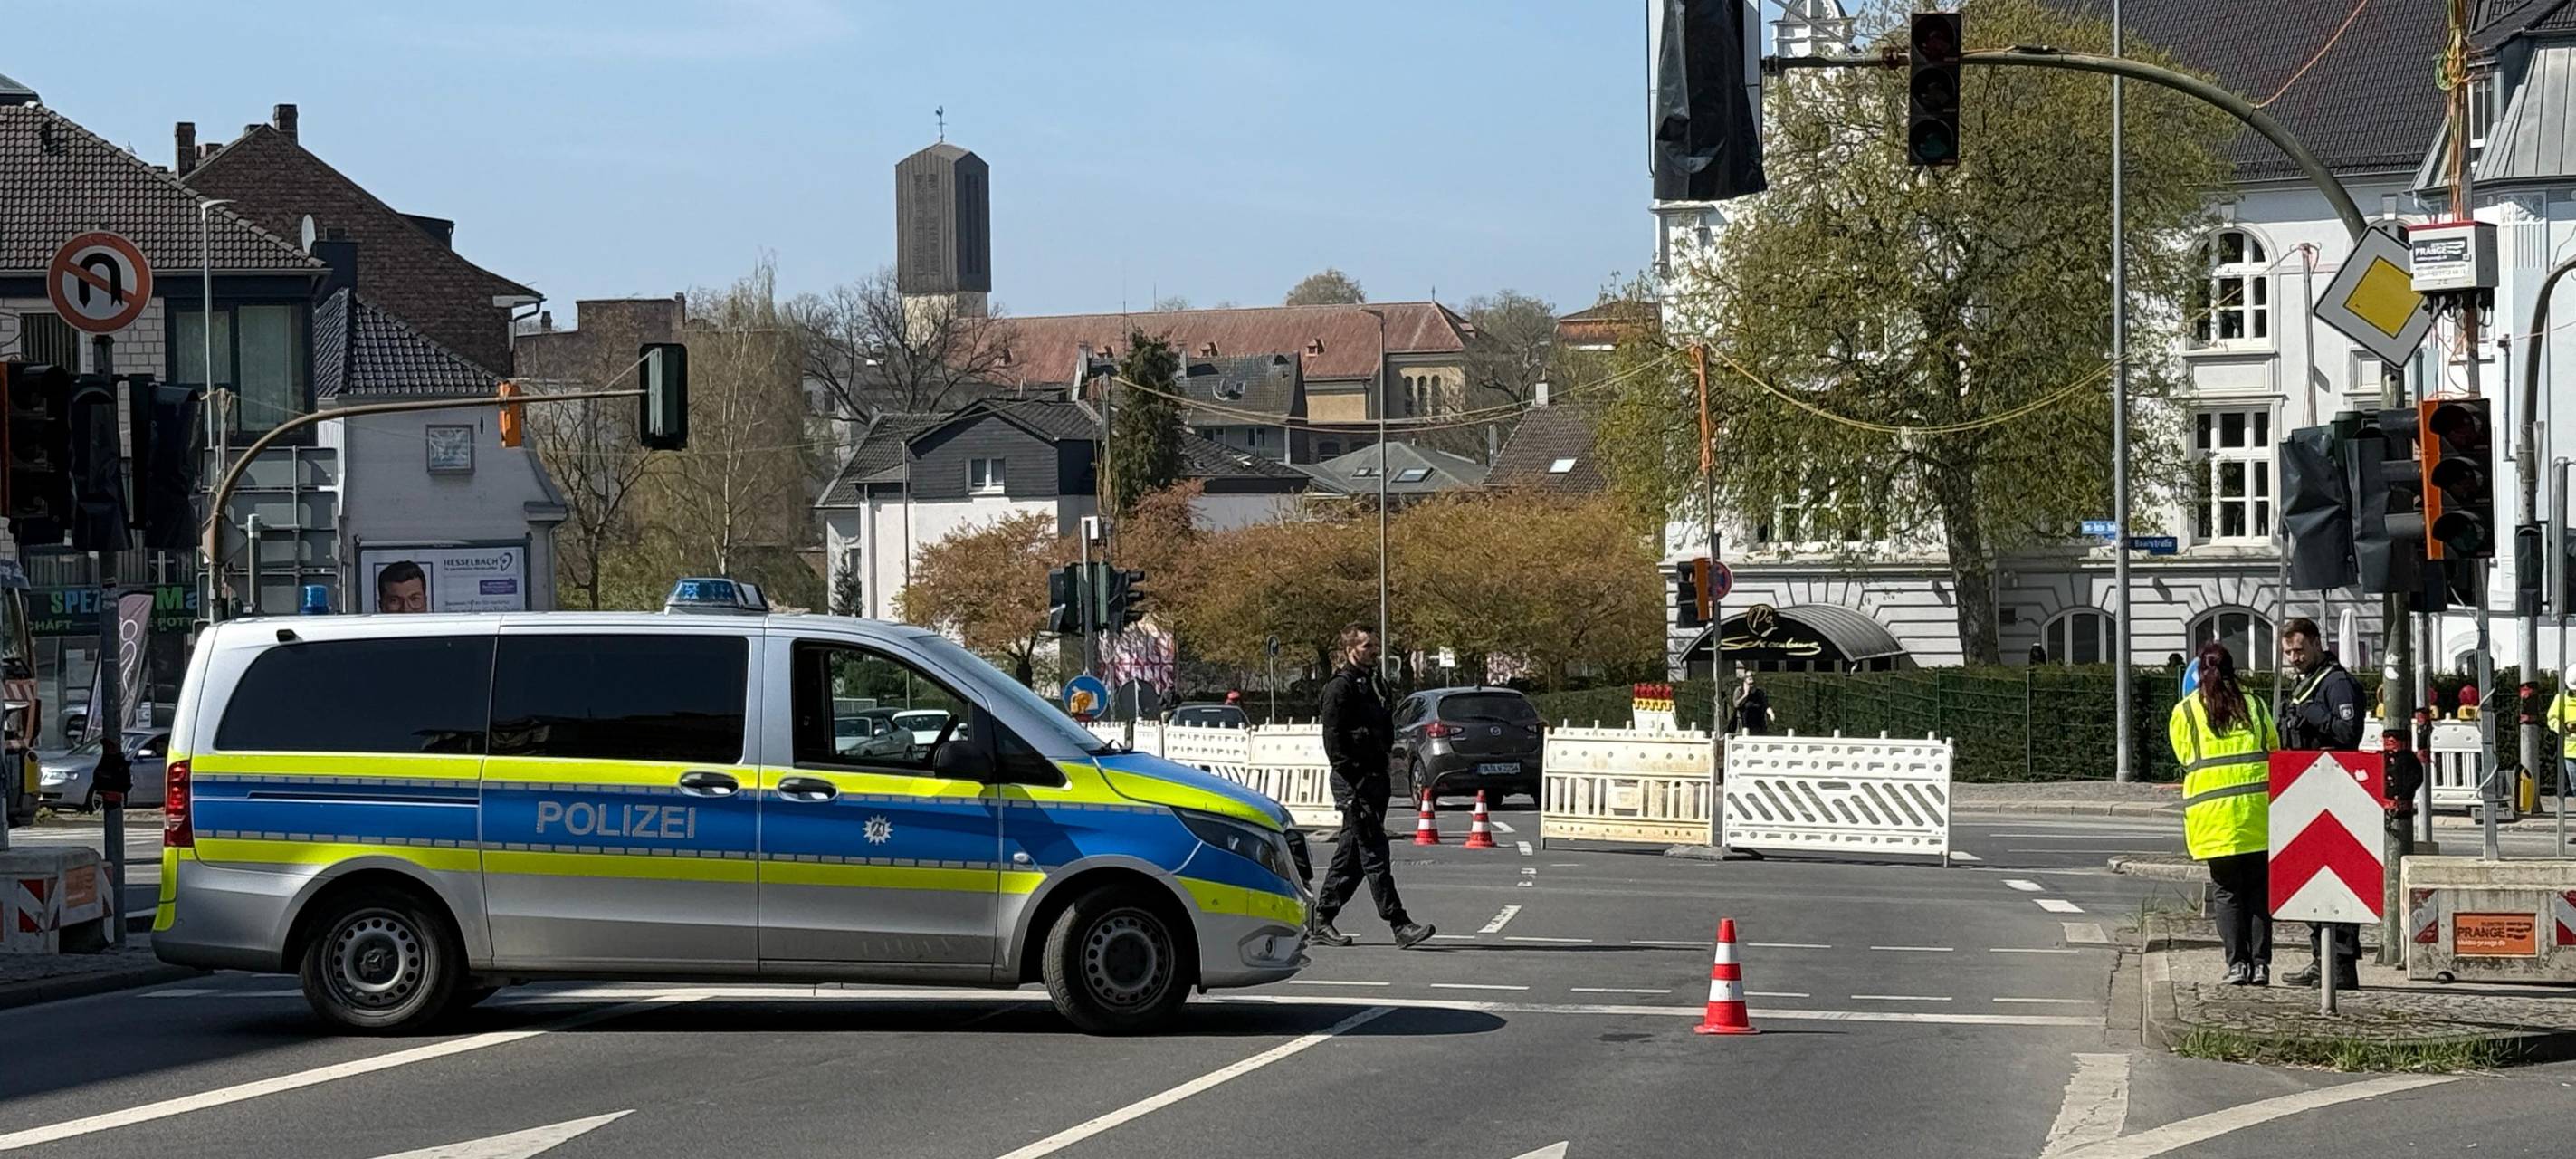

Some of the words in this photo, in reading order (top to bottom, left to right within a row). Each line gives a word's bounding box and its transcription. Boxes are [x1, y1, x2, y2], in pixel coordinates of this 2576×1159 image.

[444, 558, 499, 567] HESSELBACH
[536, 800, 696, 839] POLIZEI
[2457, 926, 2505, 938] PRANGE
